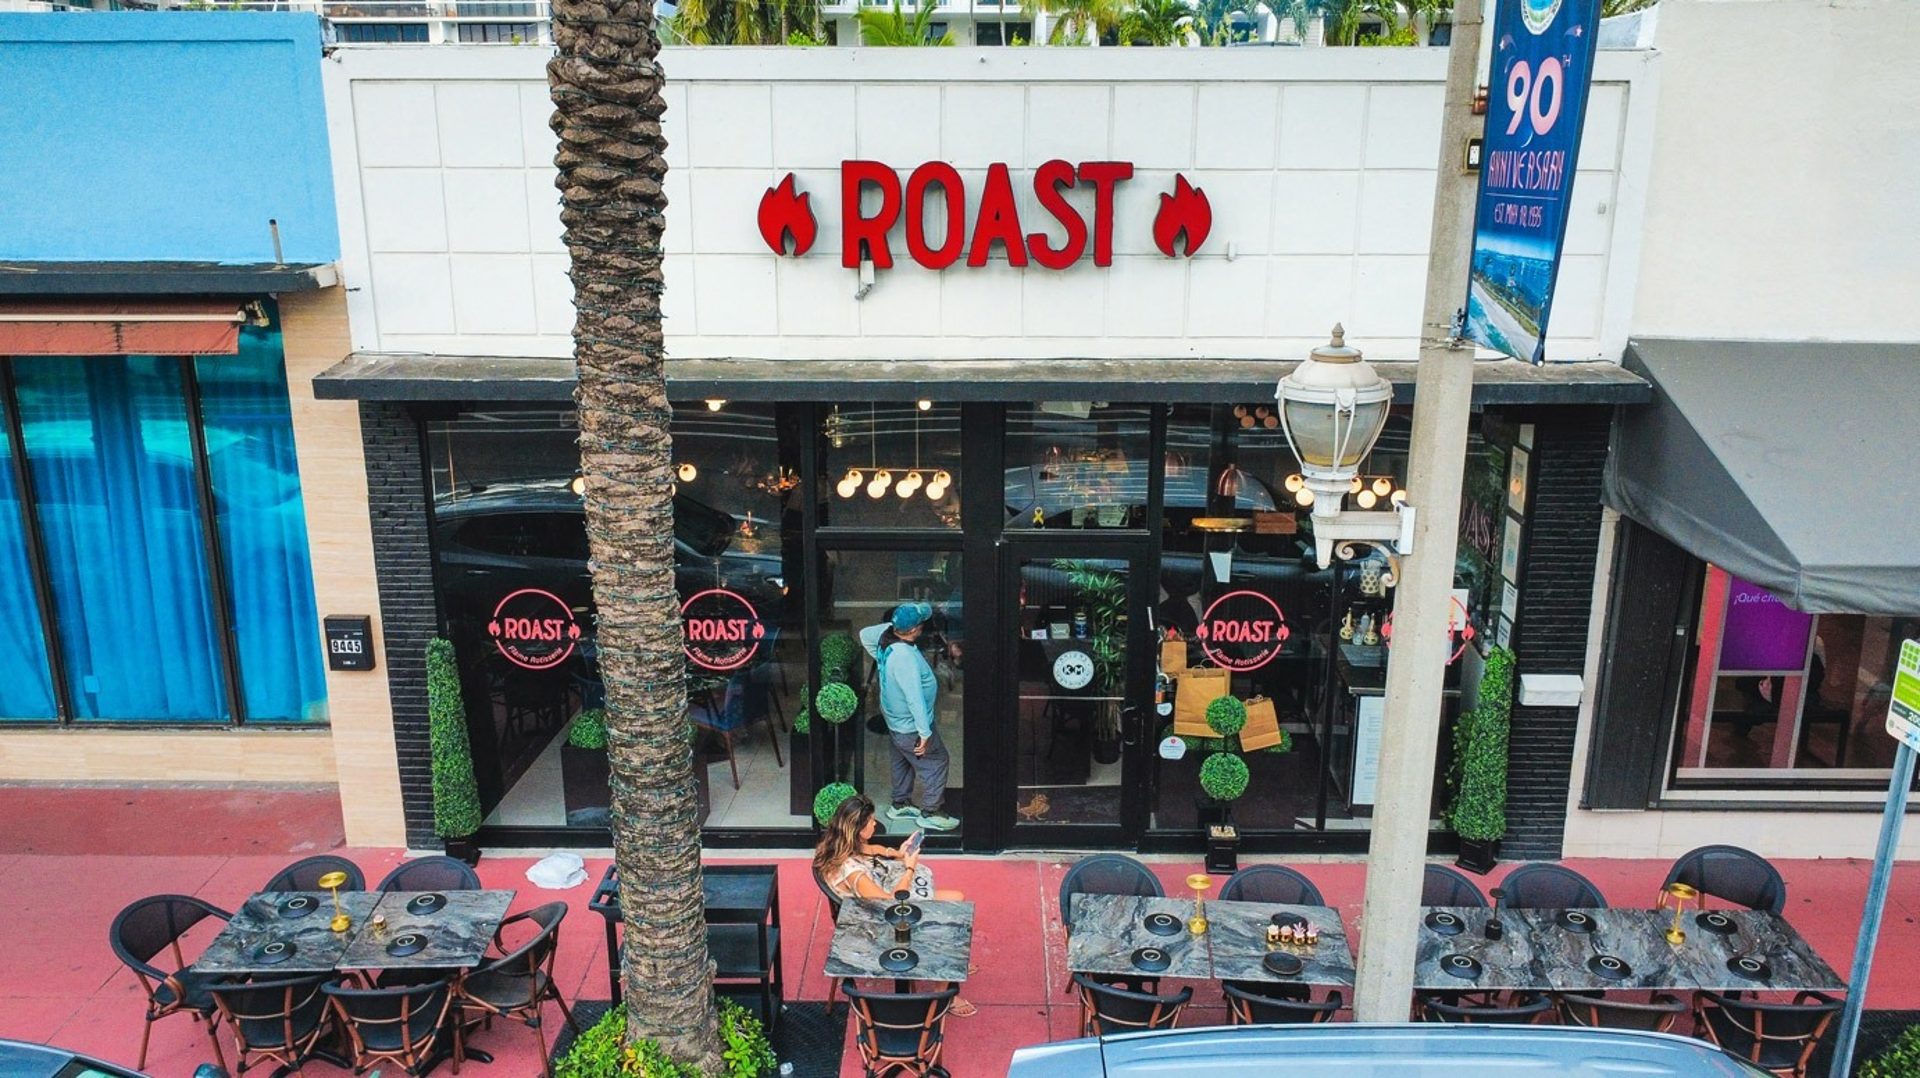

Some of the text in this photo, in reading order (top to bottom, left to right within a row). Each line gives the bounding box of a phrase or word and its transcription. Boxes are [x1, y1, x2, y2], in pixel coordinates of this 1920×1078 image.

[1487, 150, 1565, 191] ANNIVERSARY
[841, 159, 1134, 270] ROAST
[504, 617, 565, 641] ROAST
[688, 618, 749, 642] ROAST
[1213, 620, 1274, 643] ROAST
[332, 640, 361, 653] 9445
[508, 645, 529, 662] Flame
